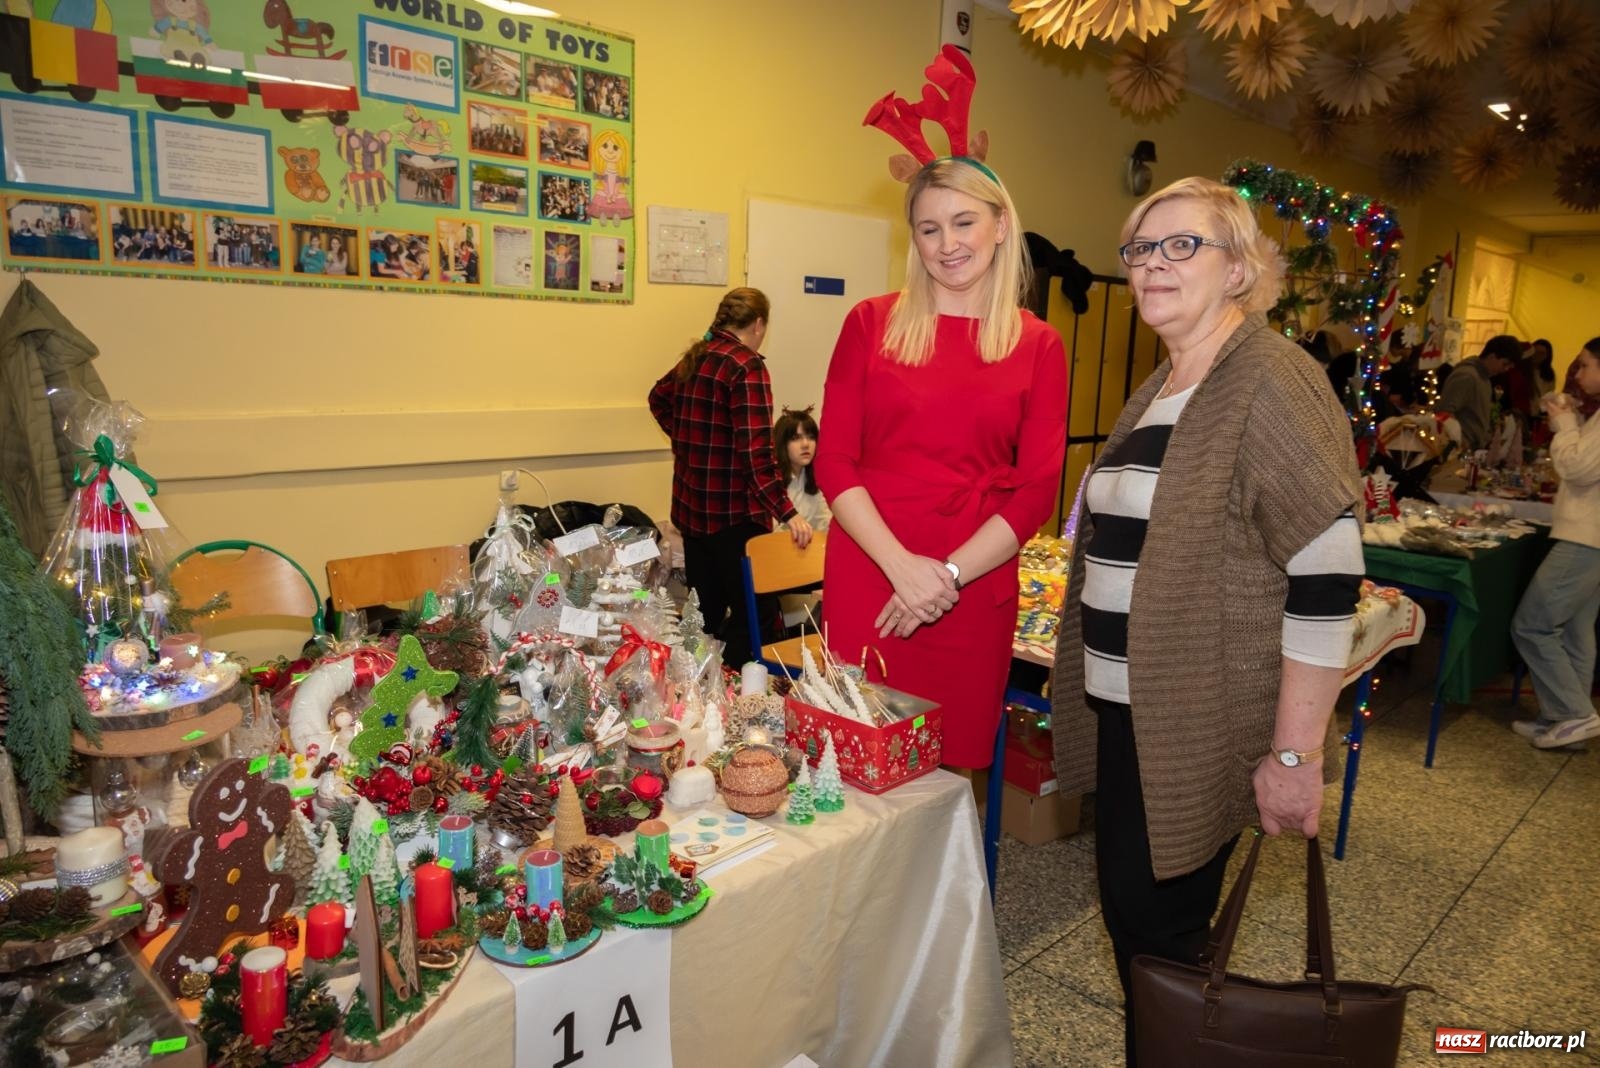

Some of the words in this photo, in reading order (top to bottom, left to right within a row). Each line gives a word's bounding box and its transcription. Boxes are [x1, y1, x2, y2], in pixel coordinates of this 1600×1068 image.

[498, 18, 533, 43] OF
[546, 29, 609, 63] TOYS
[552, 1011, 584, 1068] 1
[605, 994, 642, 1046] A
